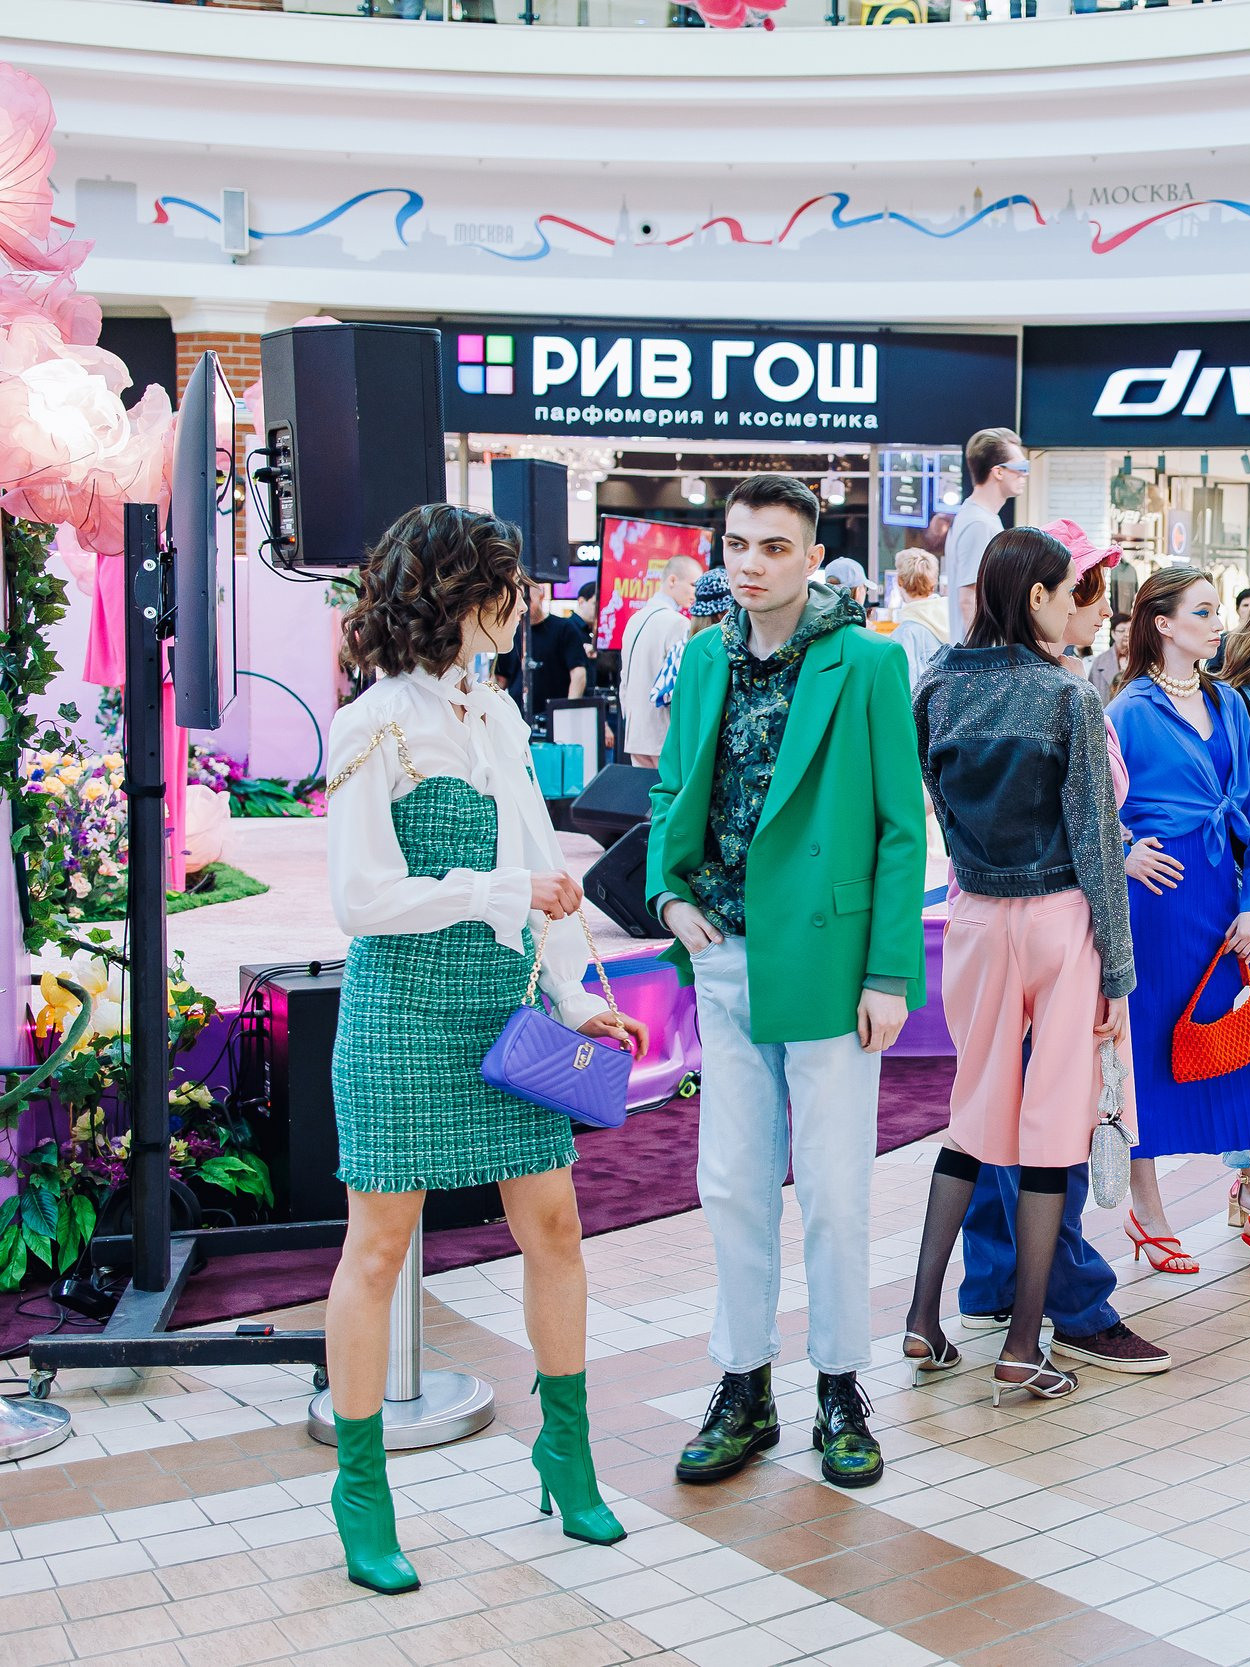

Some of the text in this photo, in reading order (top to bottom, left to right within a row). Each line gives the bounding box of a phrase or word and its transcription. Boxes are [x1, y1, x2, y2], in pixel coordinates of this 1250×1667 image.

[1089, 182, 1195, 206] МОСКВА
[453, 222, 514, 243] МОСКВА
[532, 335, 878, 404] РИВ ГОШ
[534, 404, 879, 430] парфюмерия и косметика
